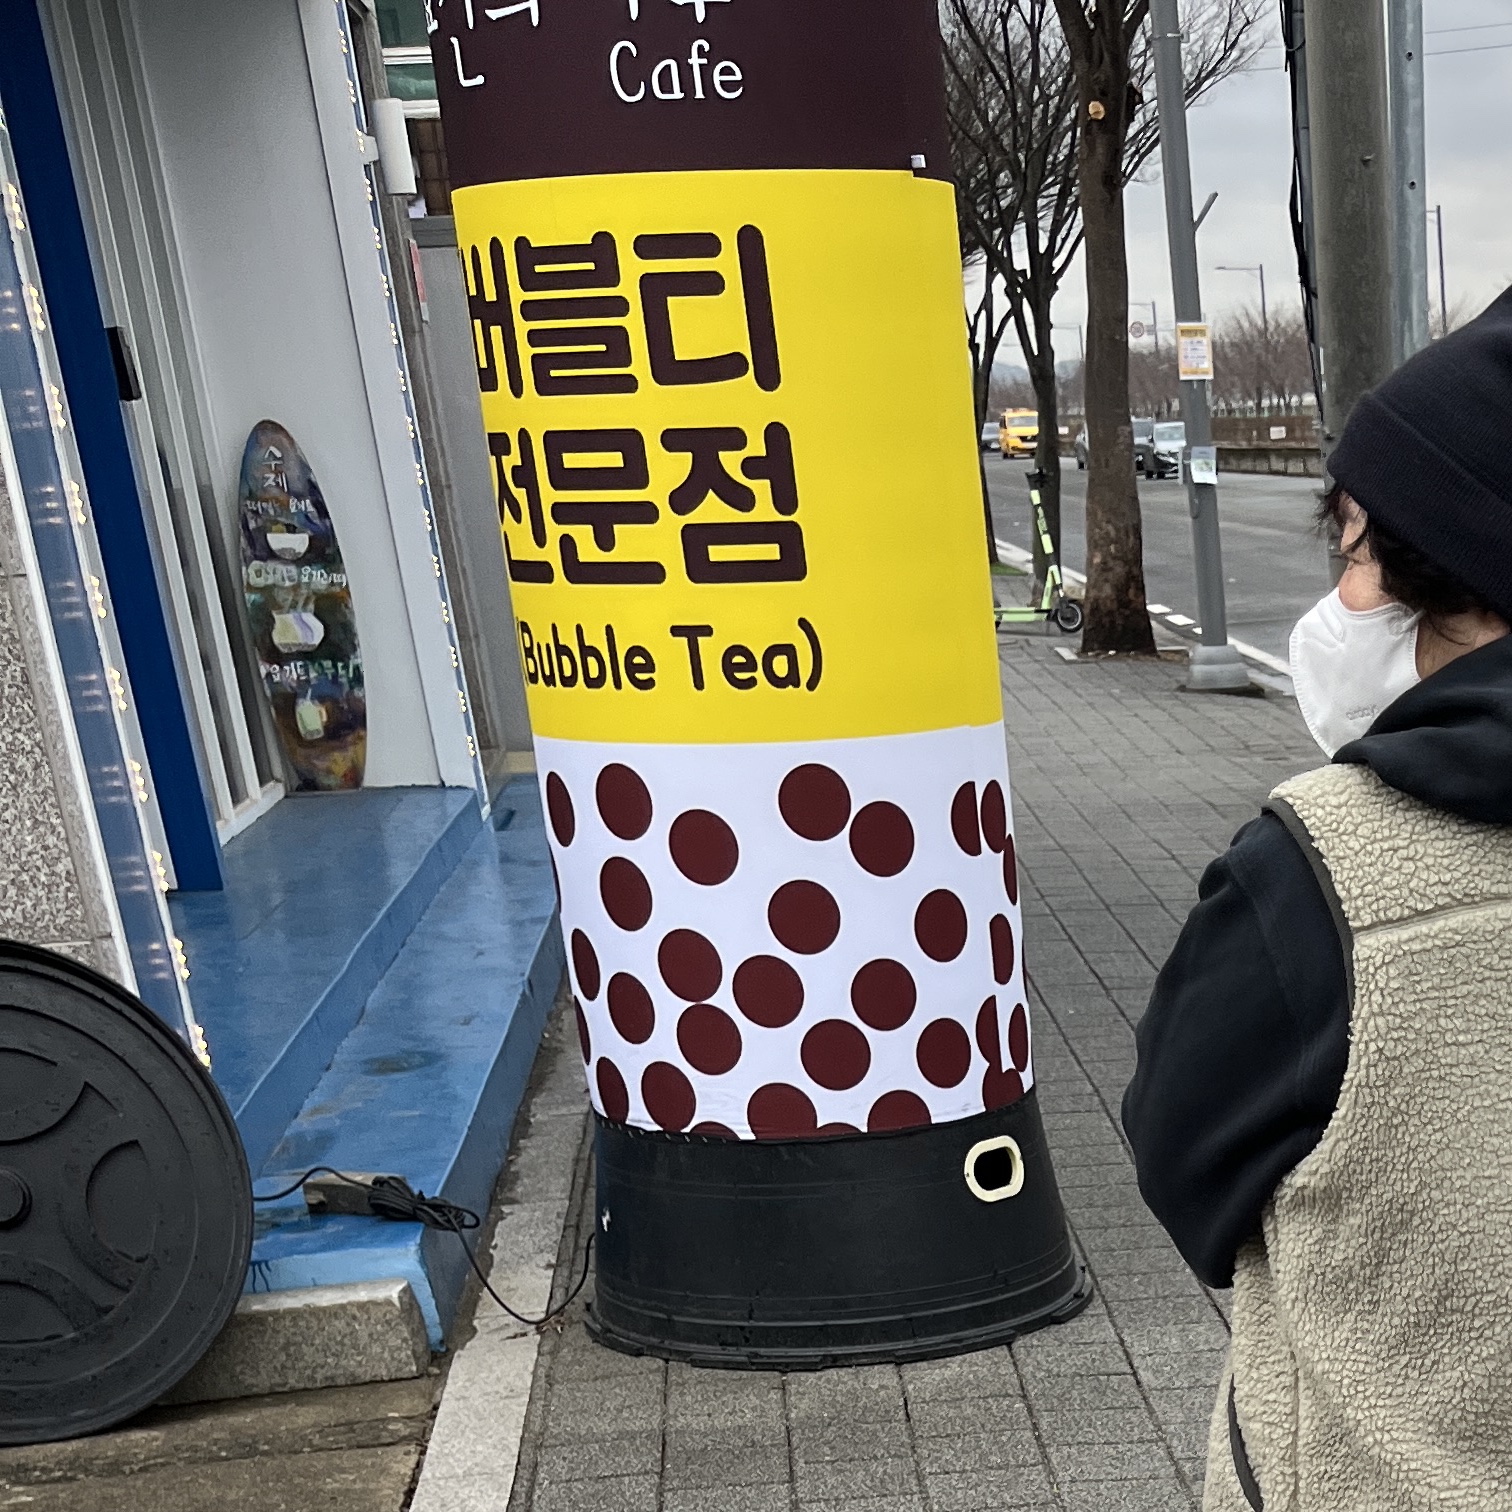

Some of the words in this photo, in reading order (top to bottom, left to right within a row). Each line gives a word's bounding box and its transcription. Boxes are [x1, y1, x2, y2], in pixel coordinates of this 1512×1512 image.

[609, 39, 744, 102] Cafe
[460, 223, 782, 400] 버블티
[487, 421, 808, 585] 전문점
[669, 617, 823, 692] Tea)
